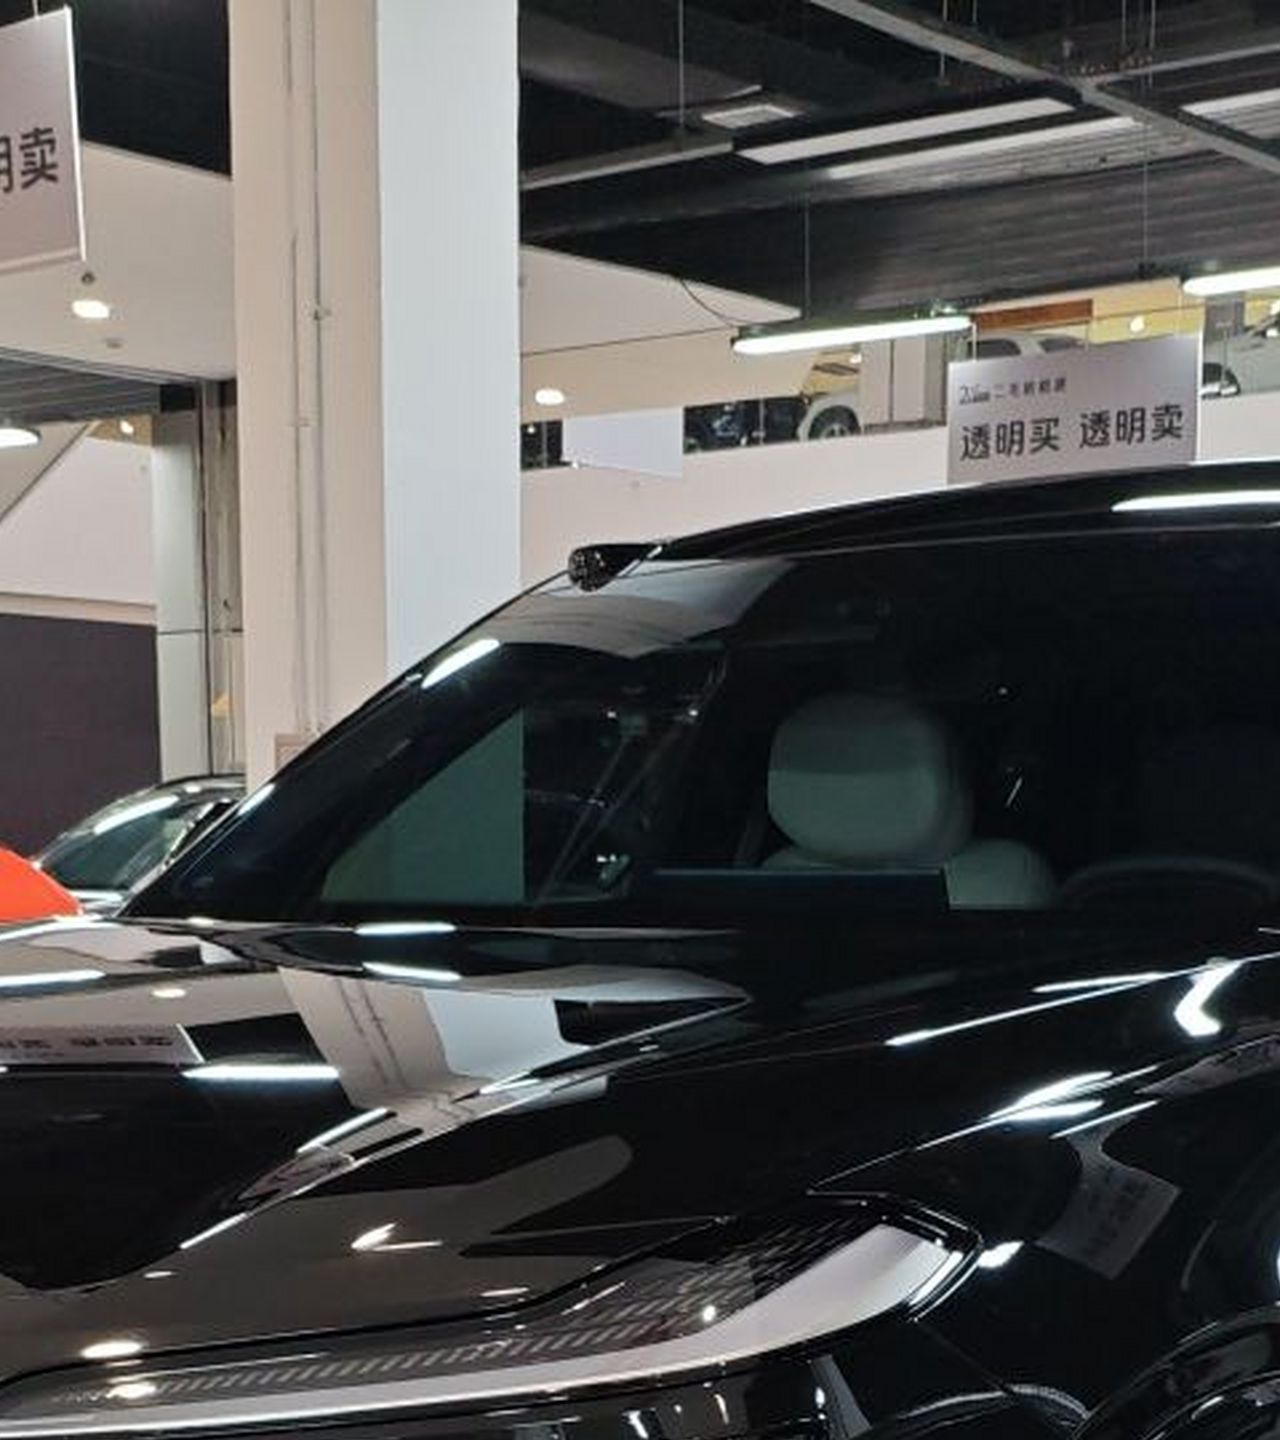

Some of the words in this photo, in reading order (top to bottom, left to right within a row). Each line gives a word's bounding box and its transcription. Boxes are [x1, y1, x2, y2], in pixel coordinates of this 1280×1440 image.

[960, 417, 1061, 462] 透明买
[1079, 404, 1184, 449] 透明卖
